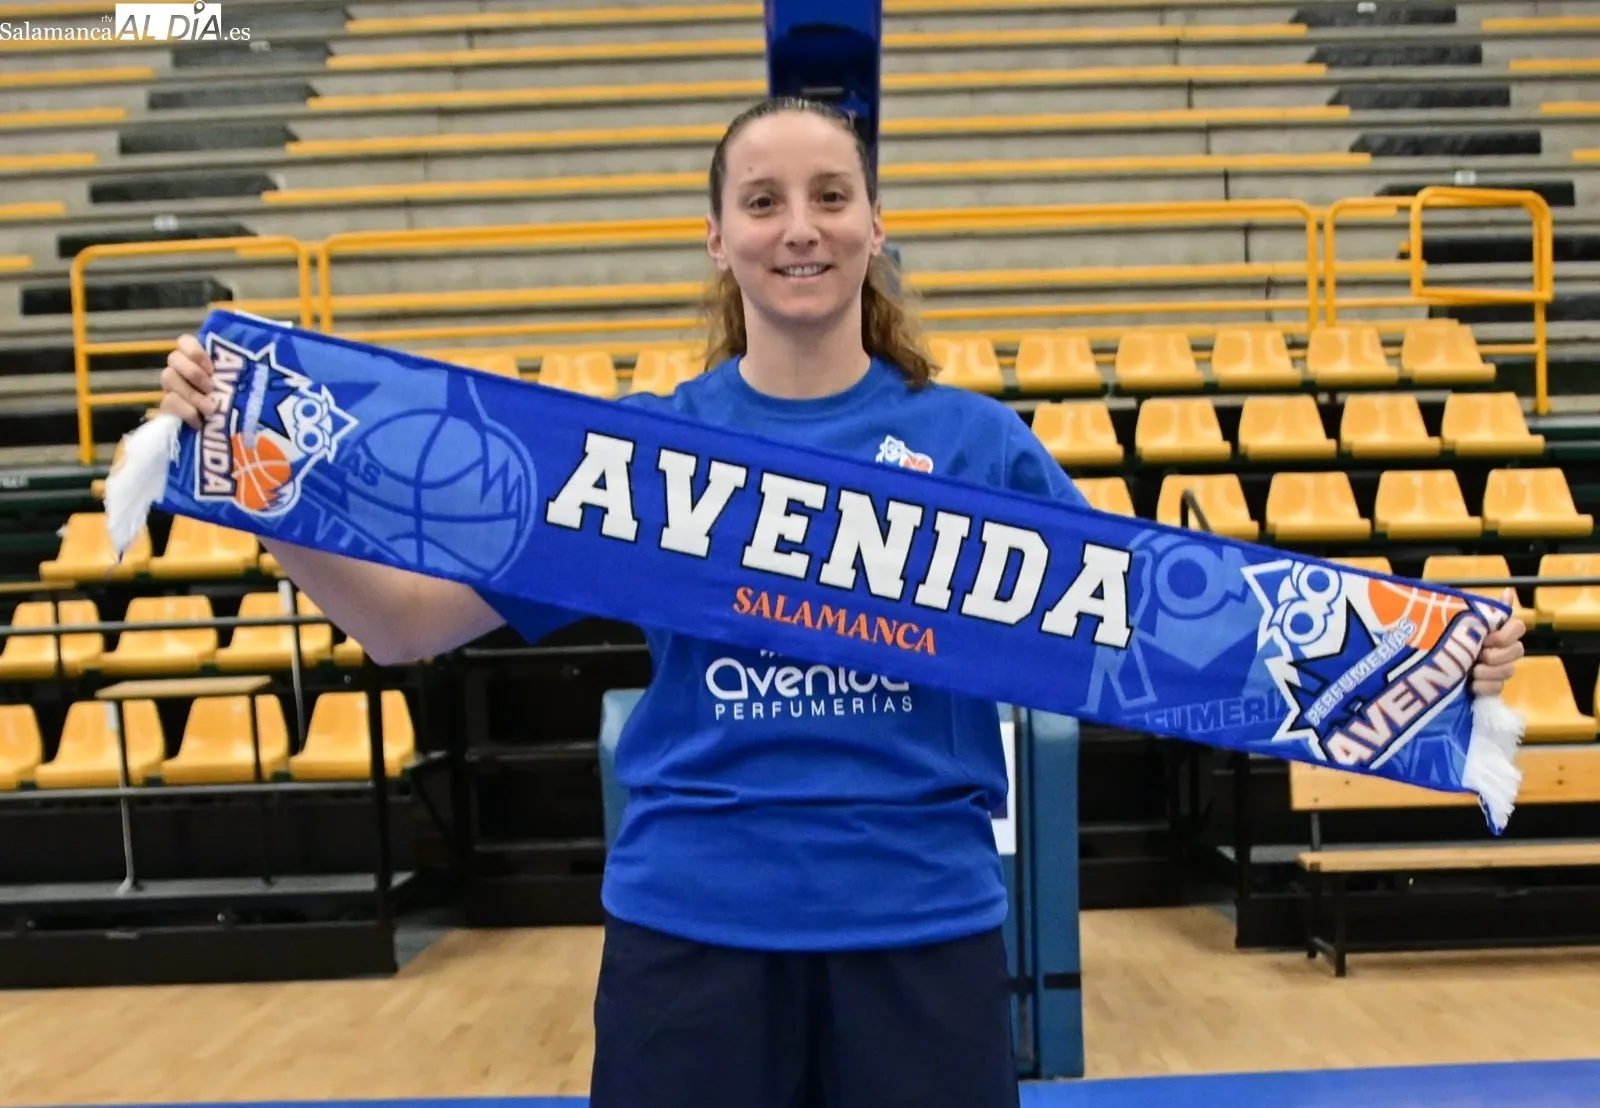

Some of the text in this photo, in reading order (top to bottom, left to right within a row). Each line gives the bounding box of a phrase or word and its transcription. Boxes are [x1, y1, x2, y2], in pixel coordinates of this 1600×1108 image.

[203, 342, 246, 495] AVENIDA
[545, 431, 1134, 650] AVENIDA
[733, 586, 937, 656] SALAMANCA
[1326, 601, 1509, 766] AVENIDA
[715, 693, 913, 721] PERFUMERÍAS
